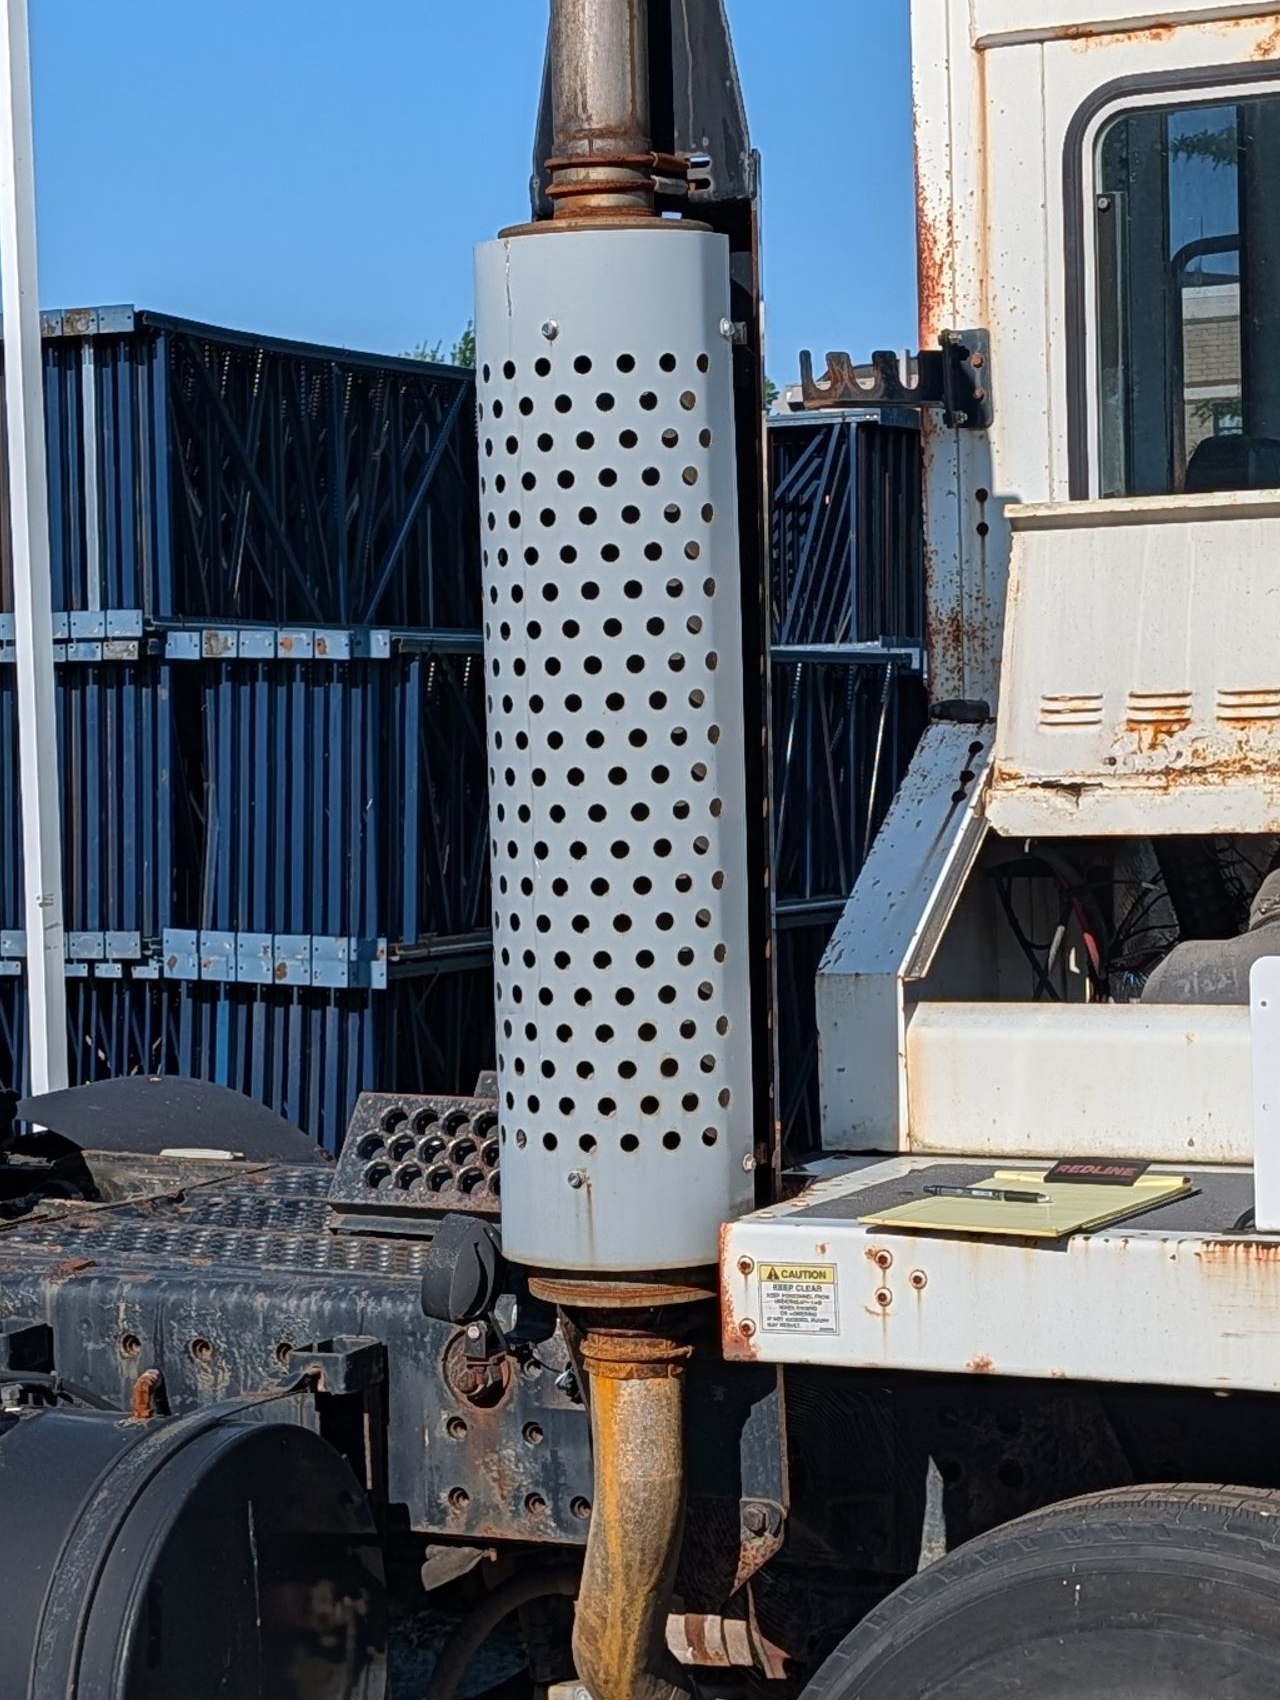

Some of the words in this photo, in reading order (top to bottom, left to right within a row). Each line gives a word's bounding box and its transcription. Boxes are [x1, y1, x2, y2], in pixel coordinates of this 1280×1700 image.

[1055, 1164, 1139, 1176] REDLINE
[781, 1269, 826, 1280] CAUTION
[795, 1284, 823, 1292] CLEAR
